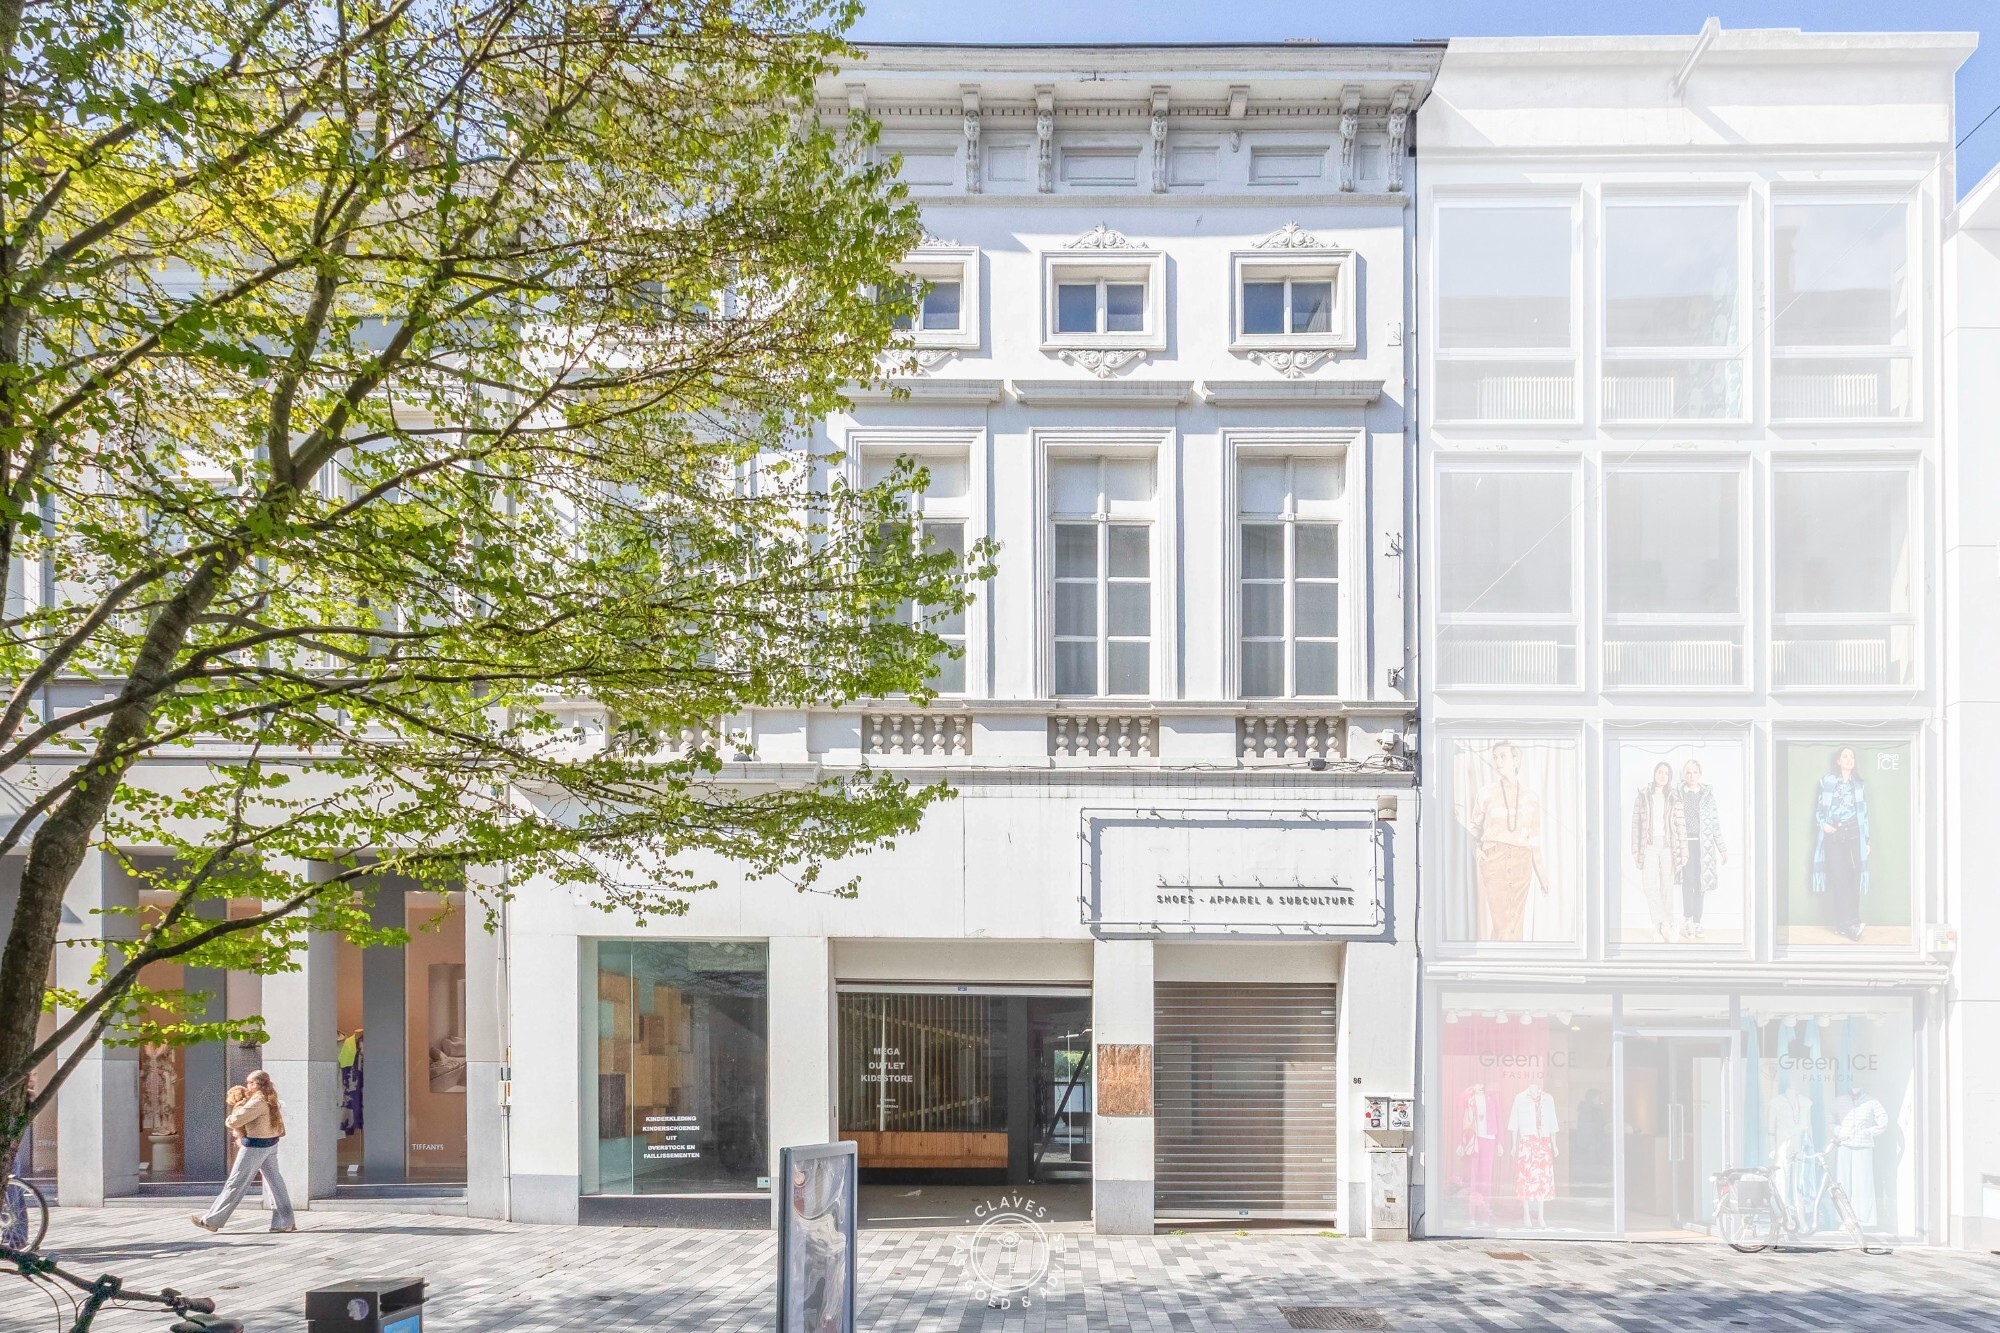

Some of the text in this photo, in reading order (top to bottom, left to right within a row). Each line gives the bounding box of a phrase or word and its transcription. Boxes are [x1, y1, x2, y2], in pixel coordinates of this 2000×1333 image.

[1877, 759, 1899, 770] ICE
[1156, 895, 1195, 905] SHOES
[1209, 895, 1262, 905] APPAREL
[1279, 896, 1355, 906] SUBCULTURE
[1479, 1050, 1577, 1068] Green ICE
[1778, 1053, 1878, 1071] Green ICE
[1802, 1074, 1854, 1082] FASHION
